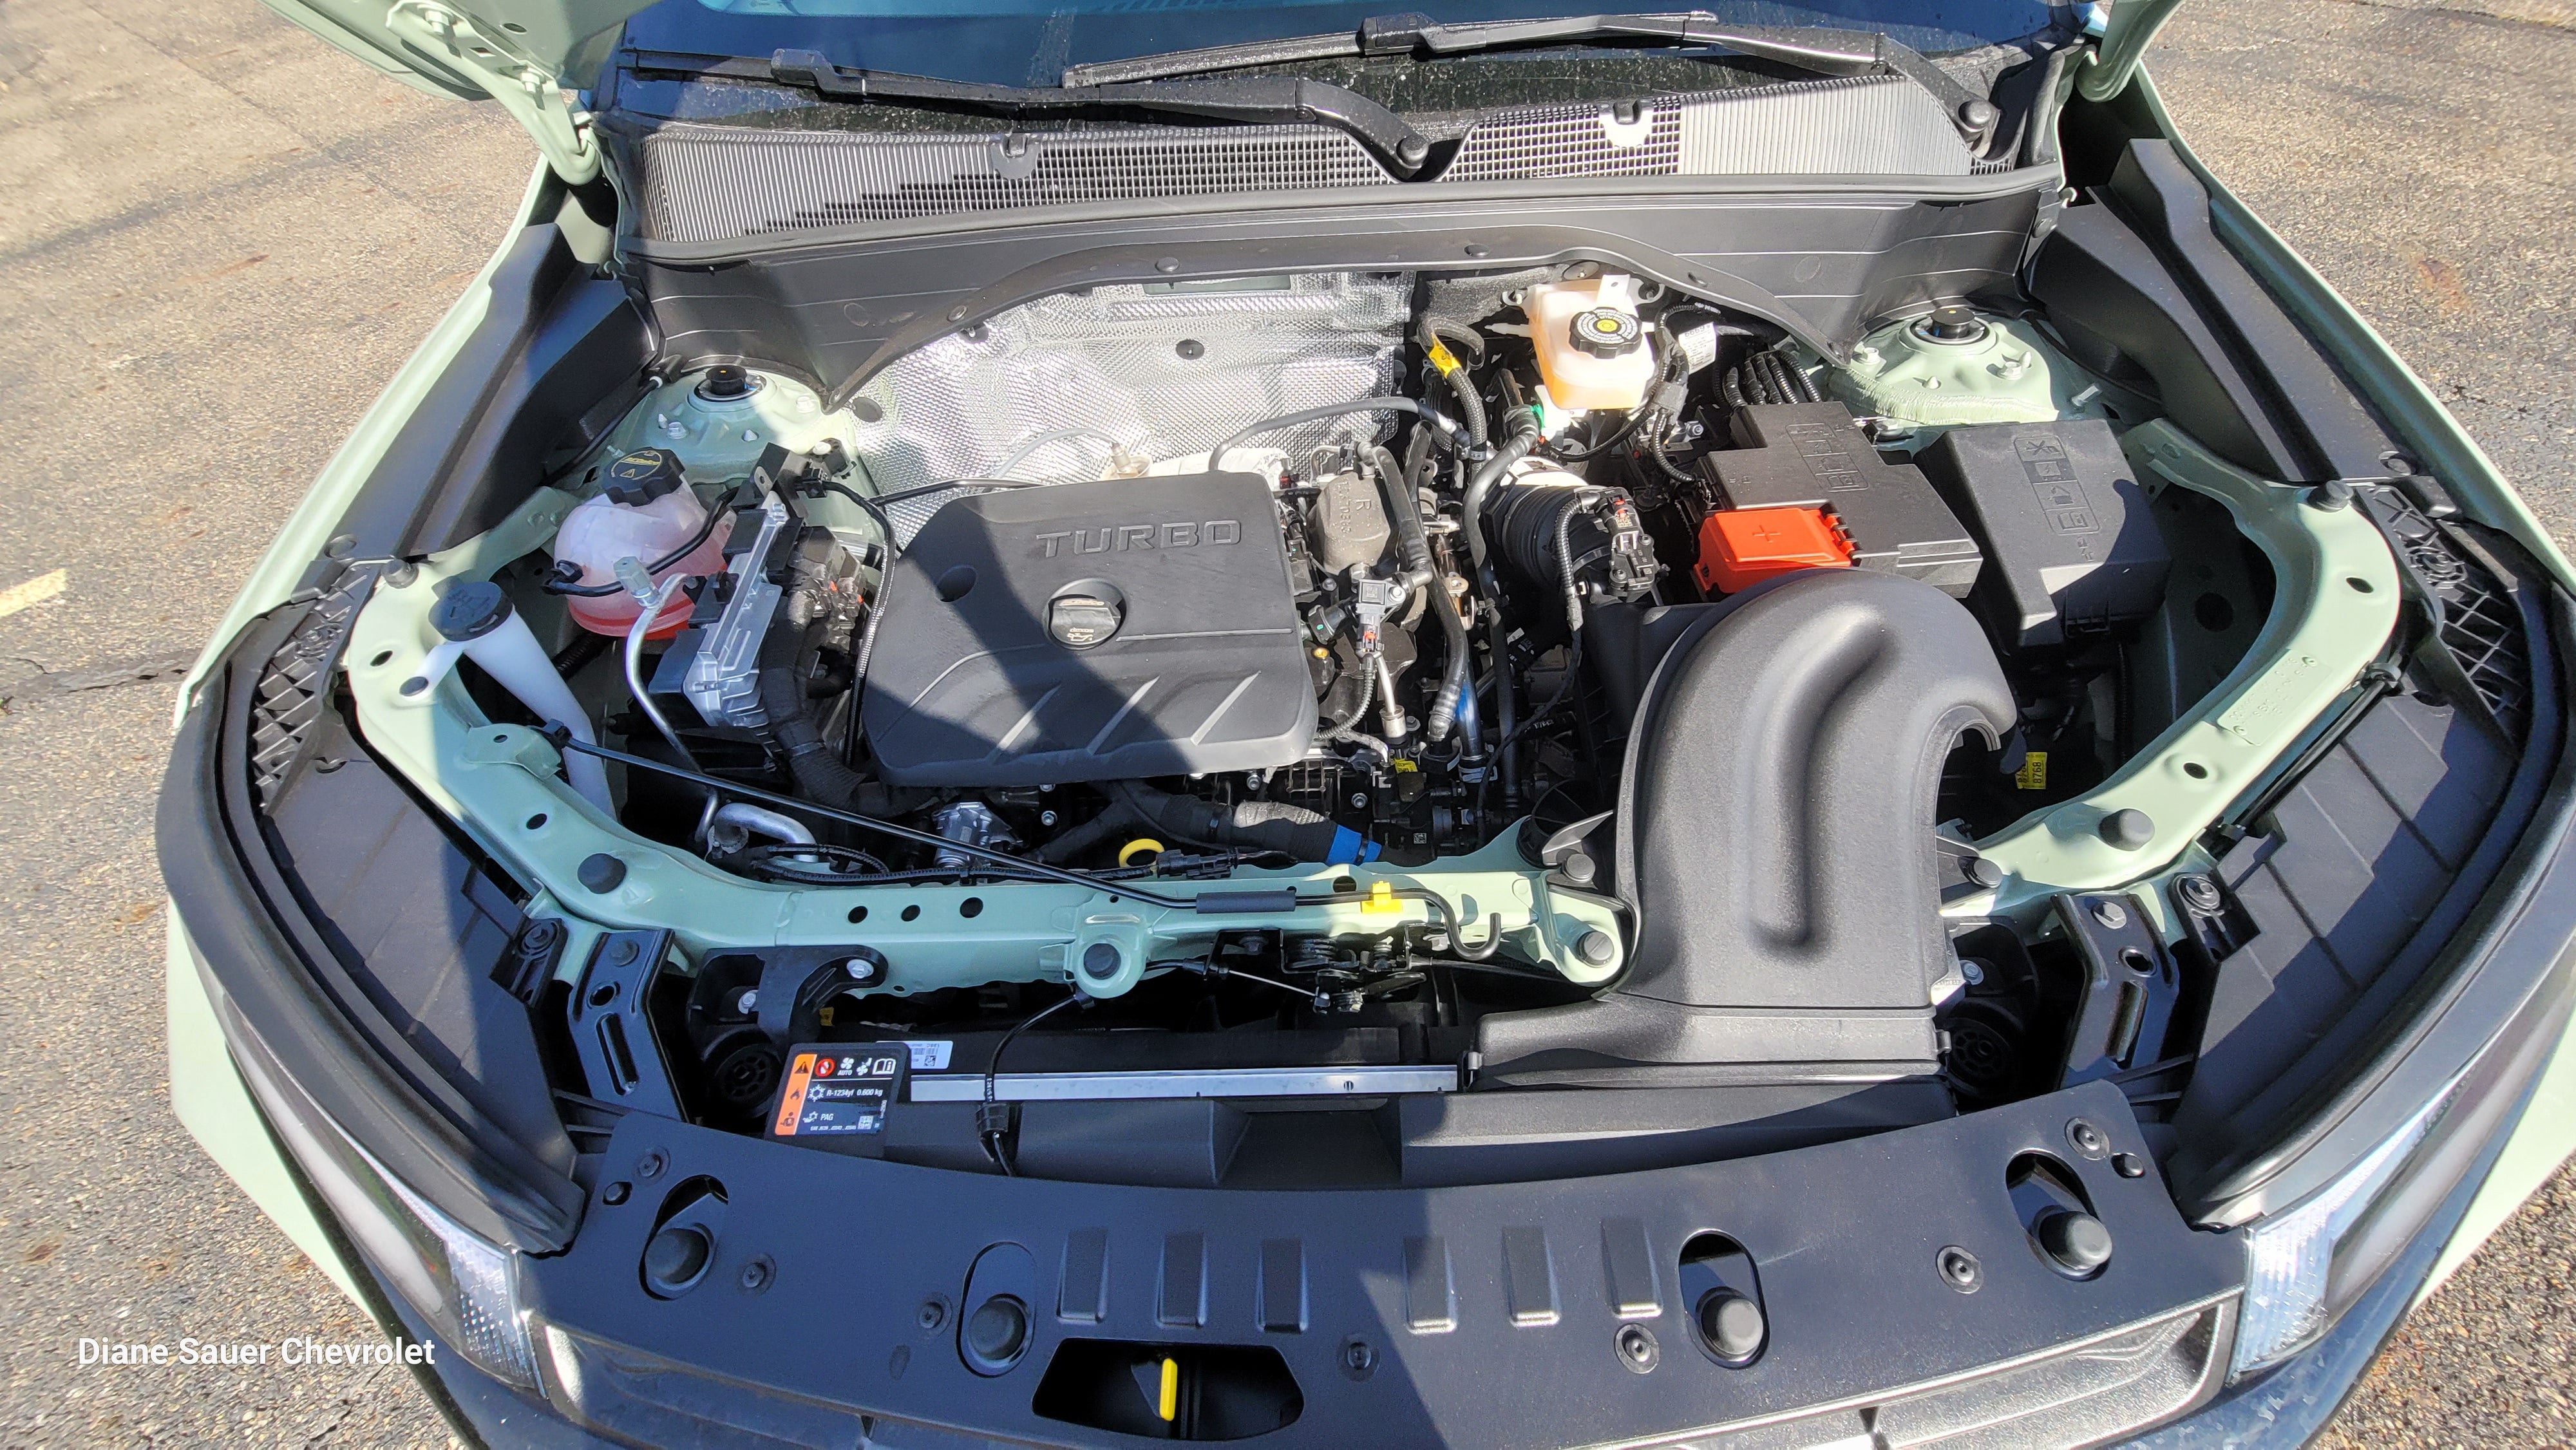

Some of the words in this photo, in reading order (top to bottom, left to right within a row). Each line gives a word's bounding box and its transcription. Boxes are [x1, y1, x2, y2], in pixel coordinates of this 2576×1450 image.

[1036, 520, 1242, 558] TURBO
[2032, 762, 2042, 784] 8768
[875, 1088, 884, 1097] kg
